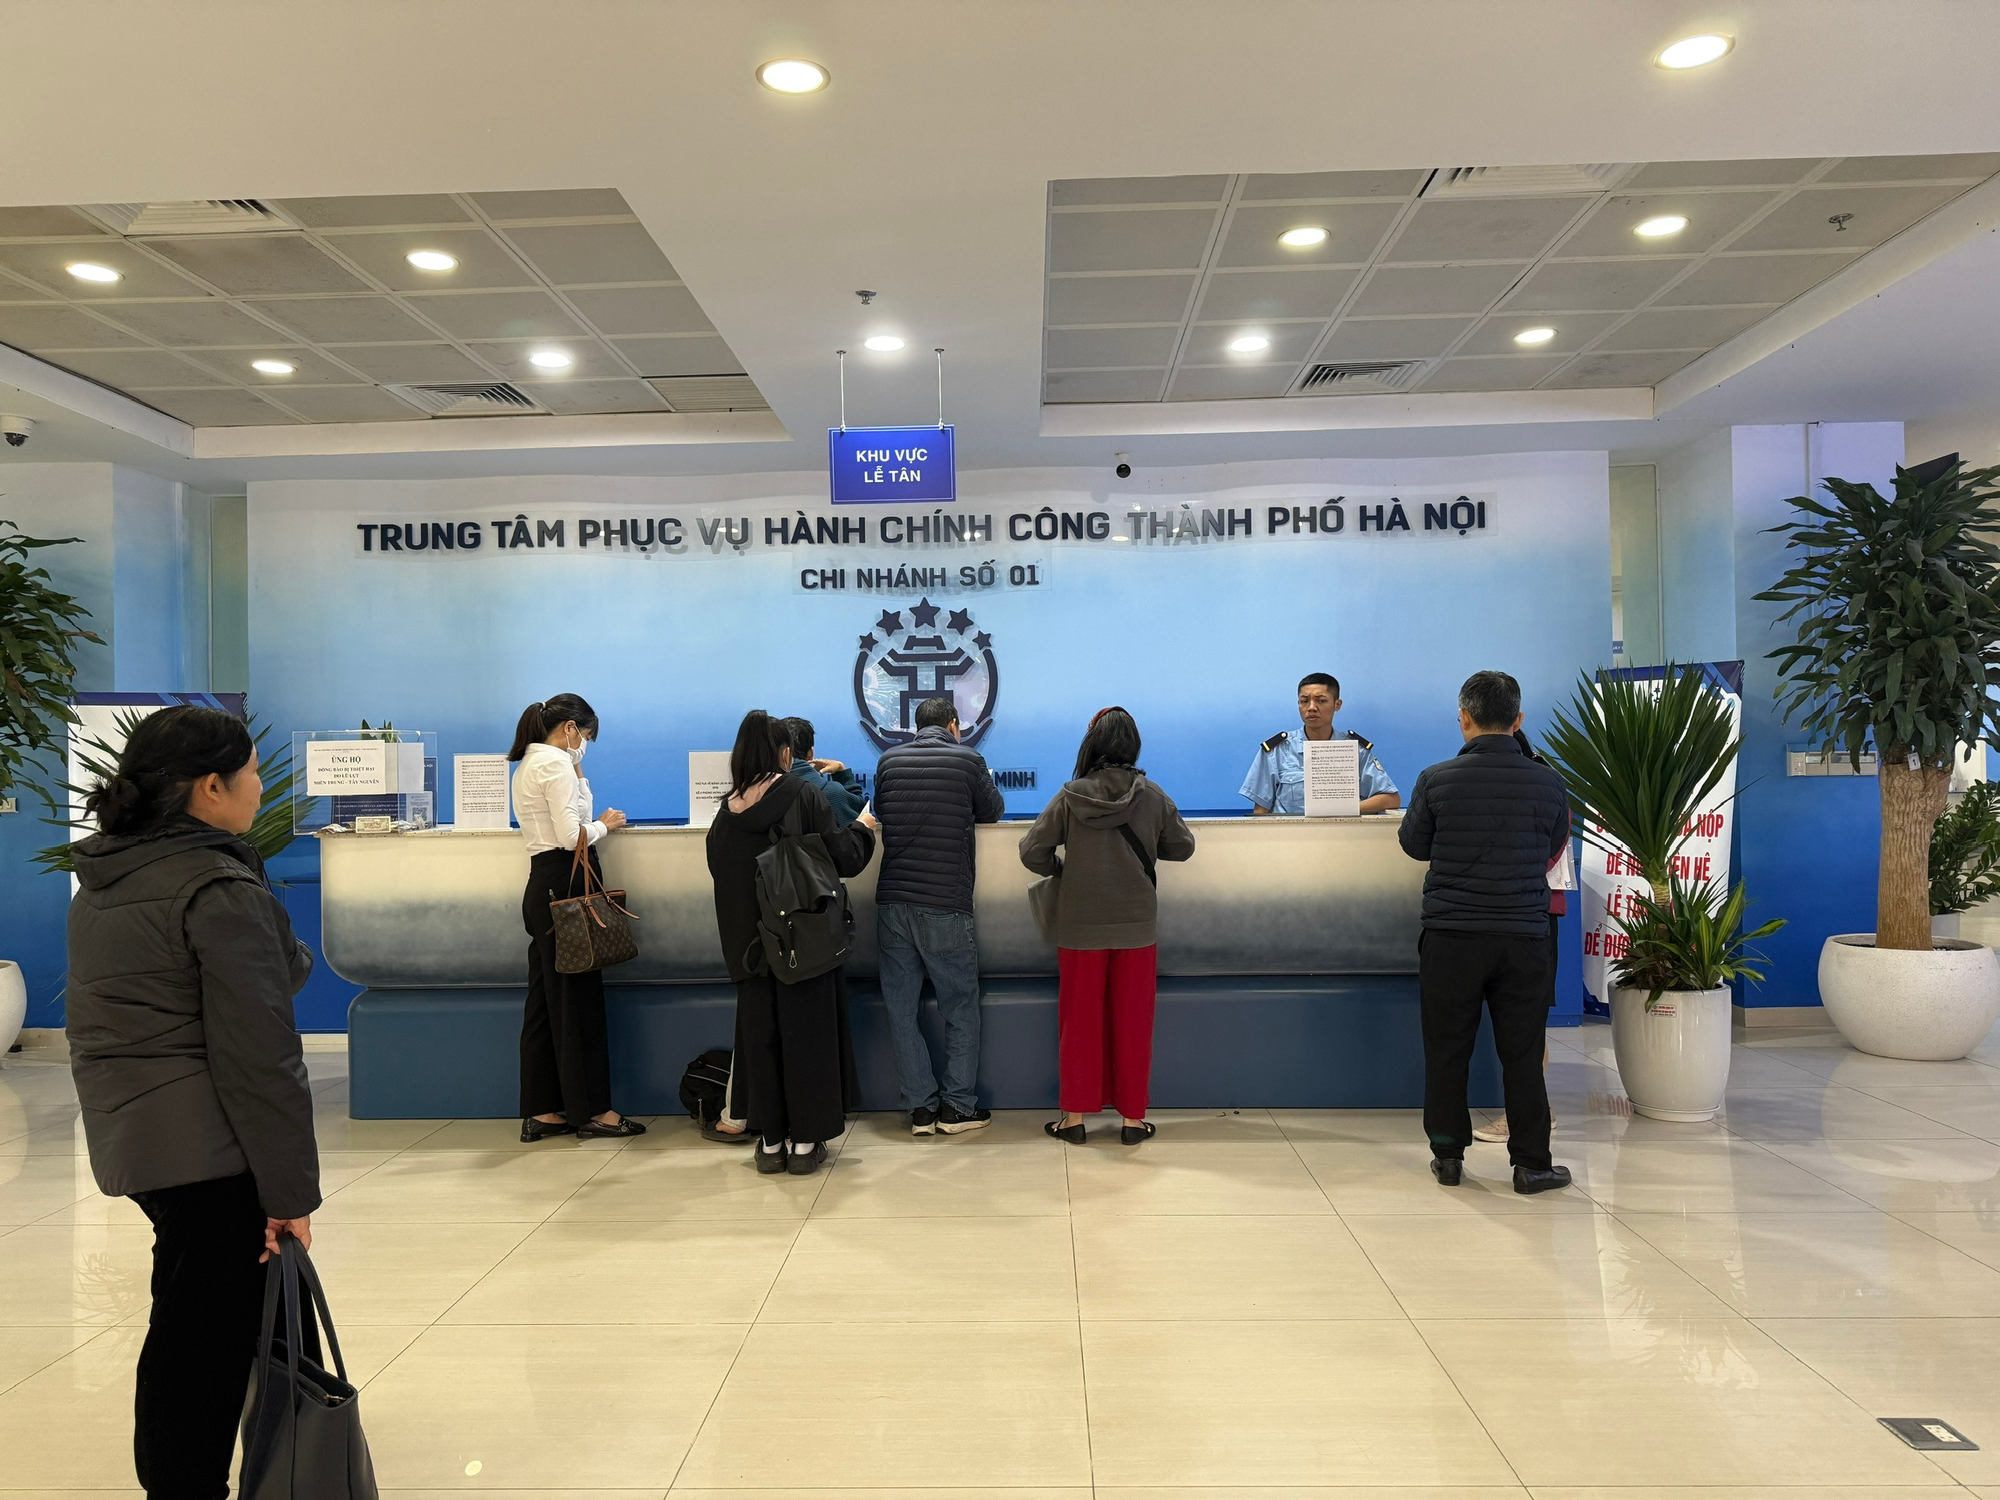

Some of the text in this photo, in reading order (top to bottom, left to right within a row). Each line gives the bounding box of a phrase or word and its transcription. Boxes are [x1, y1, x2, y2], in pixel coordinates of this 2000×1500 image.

[856, 447, 928, 464] KHU VỰC
[864, 465, 921, 483] LỄ TÂN
[356, 495, 1486, 552] TRUNG TÂM PHỤC VỤ HÀNH CHÍNH CÔNG THÀNH PHỐ HÀ NỘI
[800, 559, 1040, 589] CHI NHÁNH SỐ 01
[994, 771, 1035, 787] MINH
[1696, 809, 1724, 843] NỘP
[1606, 884, 1623, 917] LỄ
[1584, 923, 1603, 957] ĐỂ
